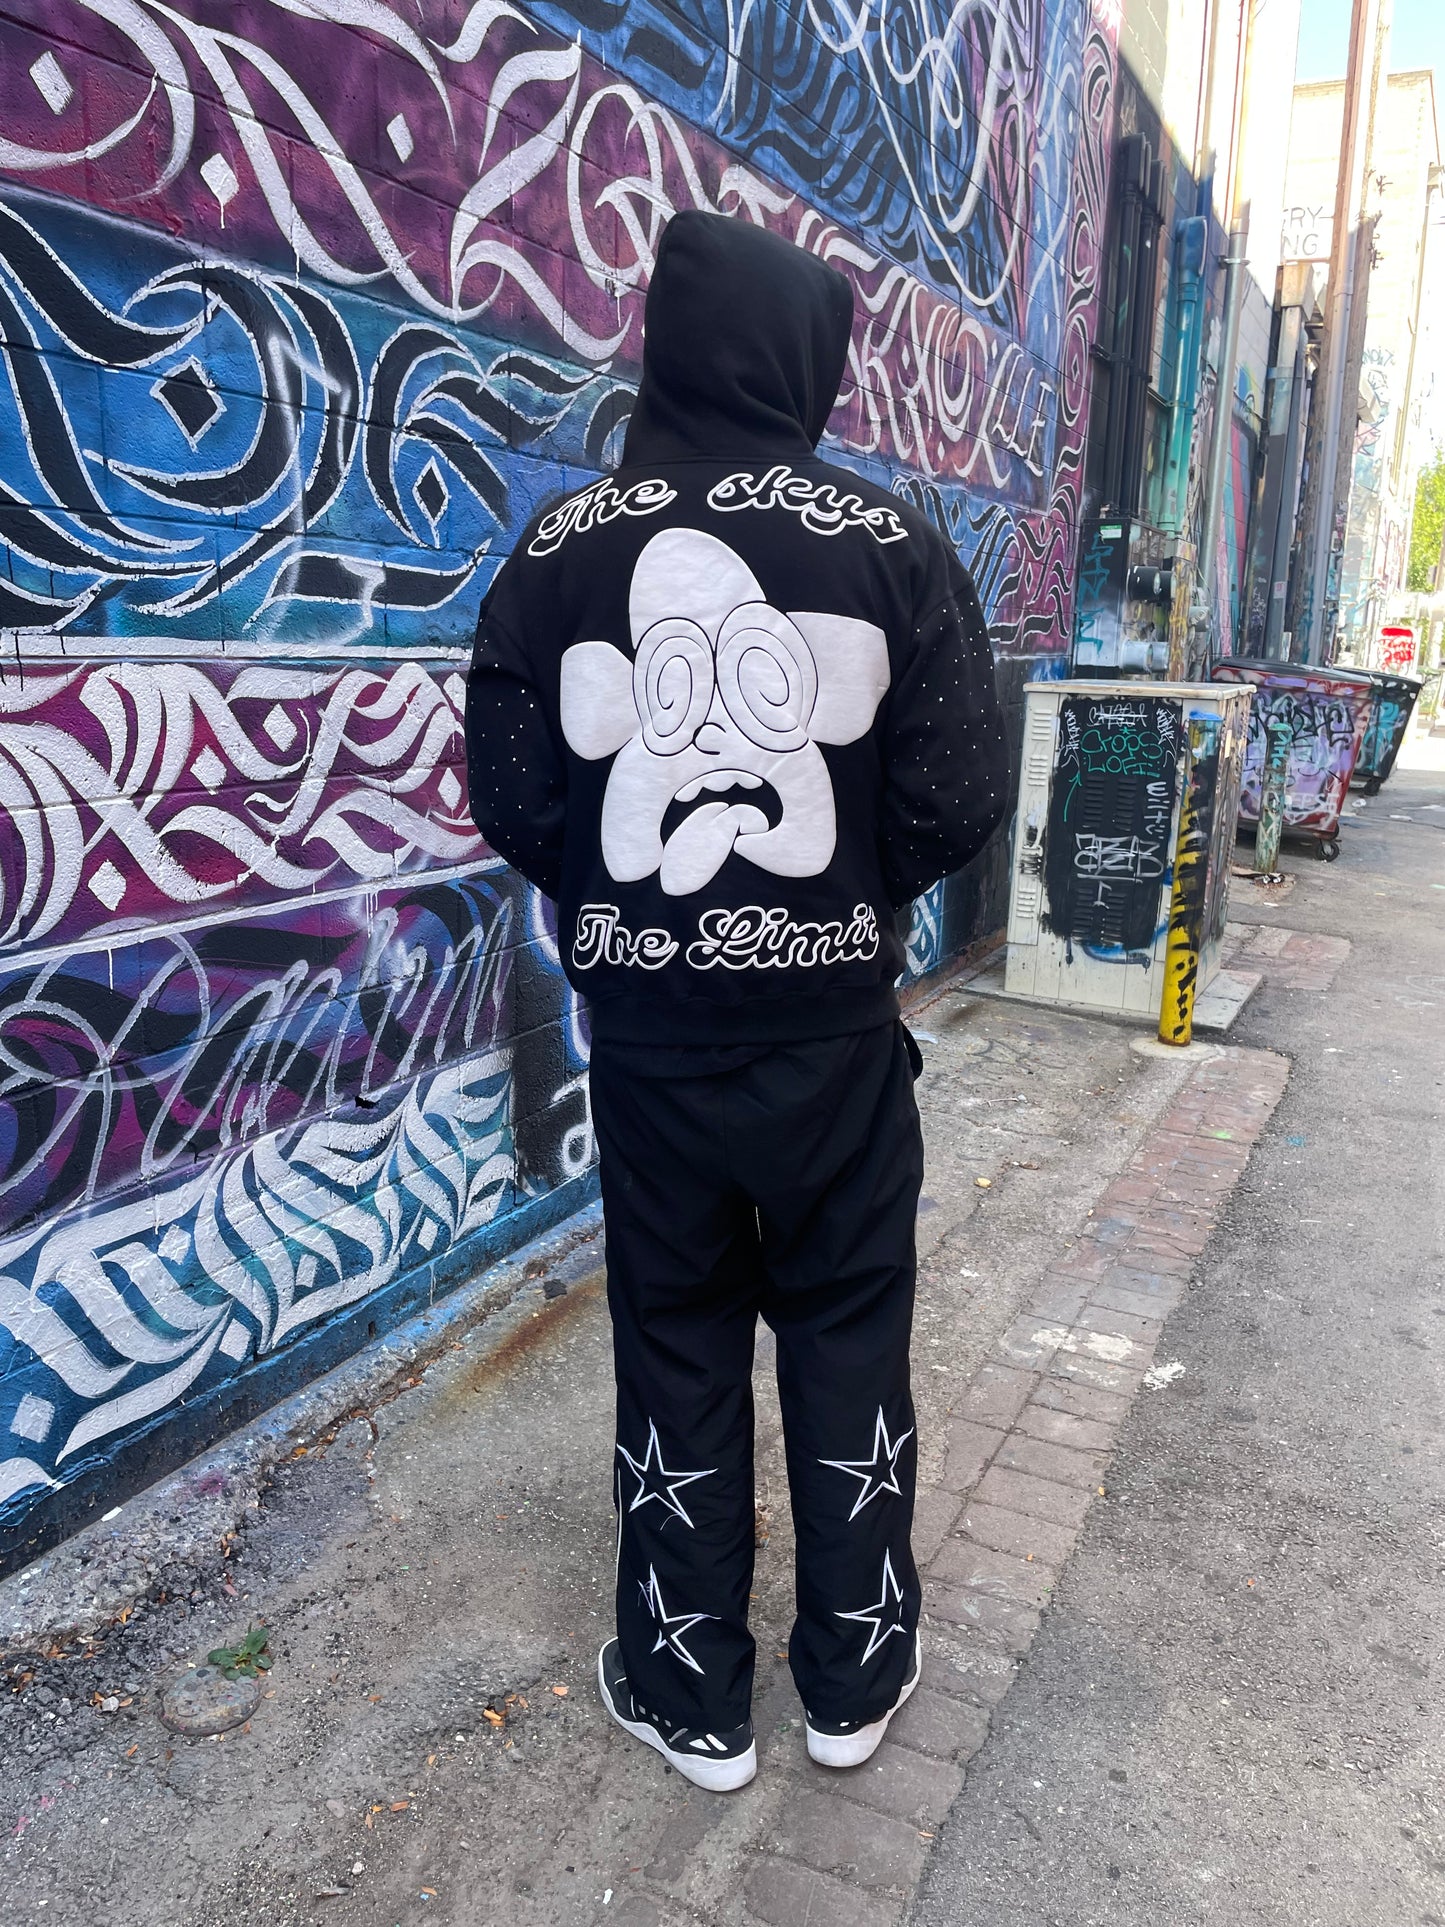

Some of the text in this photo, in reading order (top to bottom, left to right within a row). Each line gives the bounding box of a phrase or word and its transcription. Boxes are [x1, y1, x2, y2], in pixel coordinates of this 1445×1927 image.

[528, 477, 677, 556] The
[572, 903, 880, 970] The Limit
